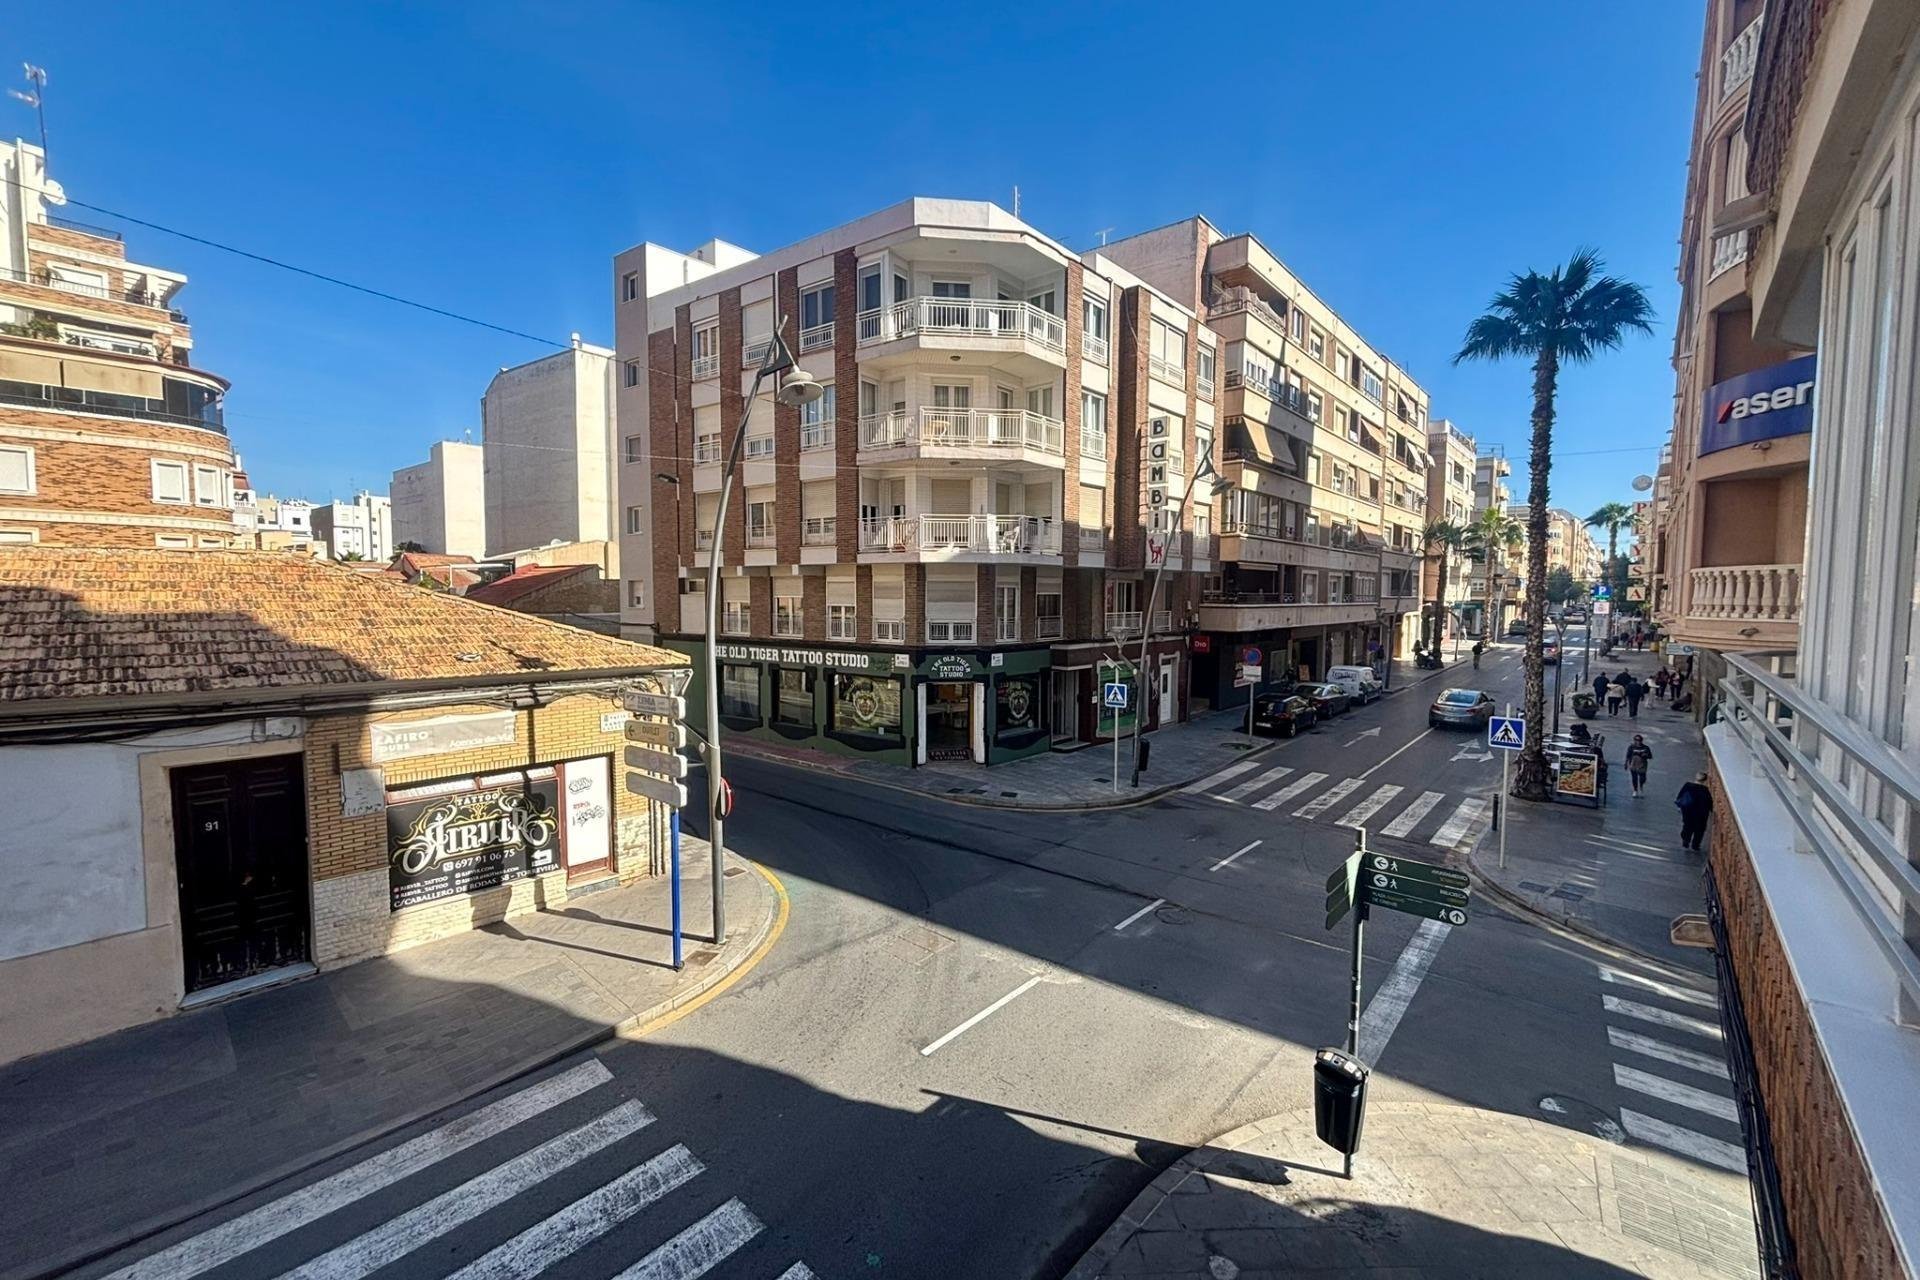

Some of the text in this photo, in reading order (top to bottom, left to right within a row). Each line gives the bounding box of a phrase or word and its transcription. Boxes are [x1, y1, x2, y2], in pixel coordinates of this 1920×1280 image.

[1731, 381, 1814, 419] aser
[714, 645, 728, 658] HE
[729, 646, 748, 659] OLD
[749, 647, 779, 662] TIGER
[782, 649, 823, 665] TATTOO
[825, 652, 869, 669] STUDIO
[931, 655, 971, 673] THE OLD TIGER
[458, 792, 500, 805] TATTOO
[205, 821, 219, 831] 91
[455, 848, 516, 869] 697 91 06 75
[394, 888, 454, 908] C/CABALLERO
[455, 884, 468, 894] DE
